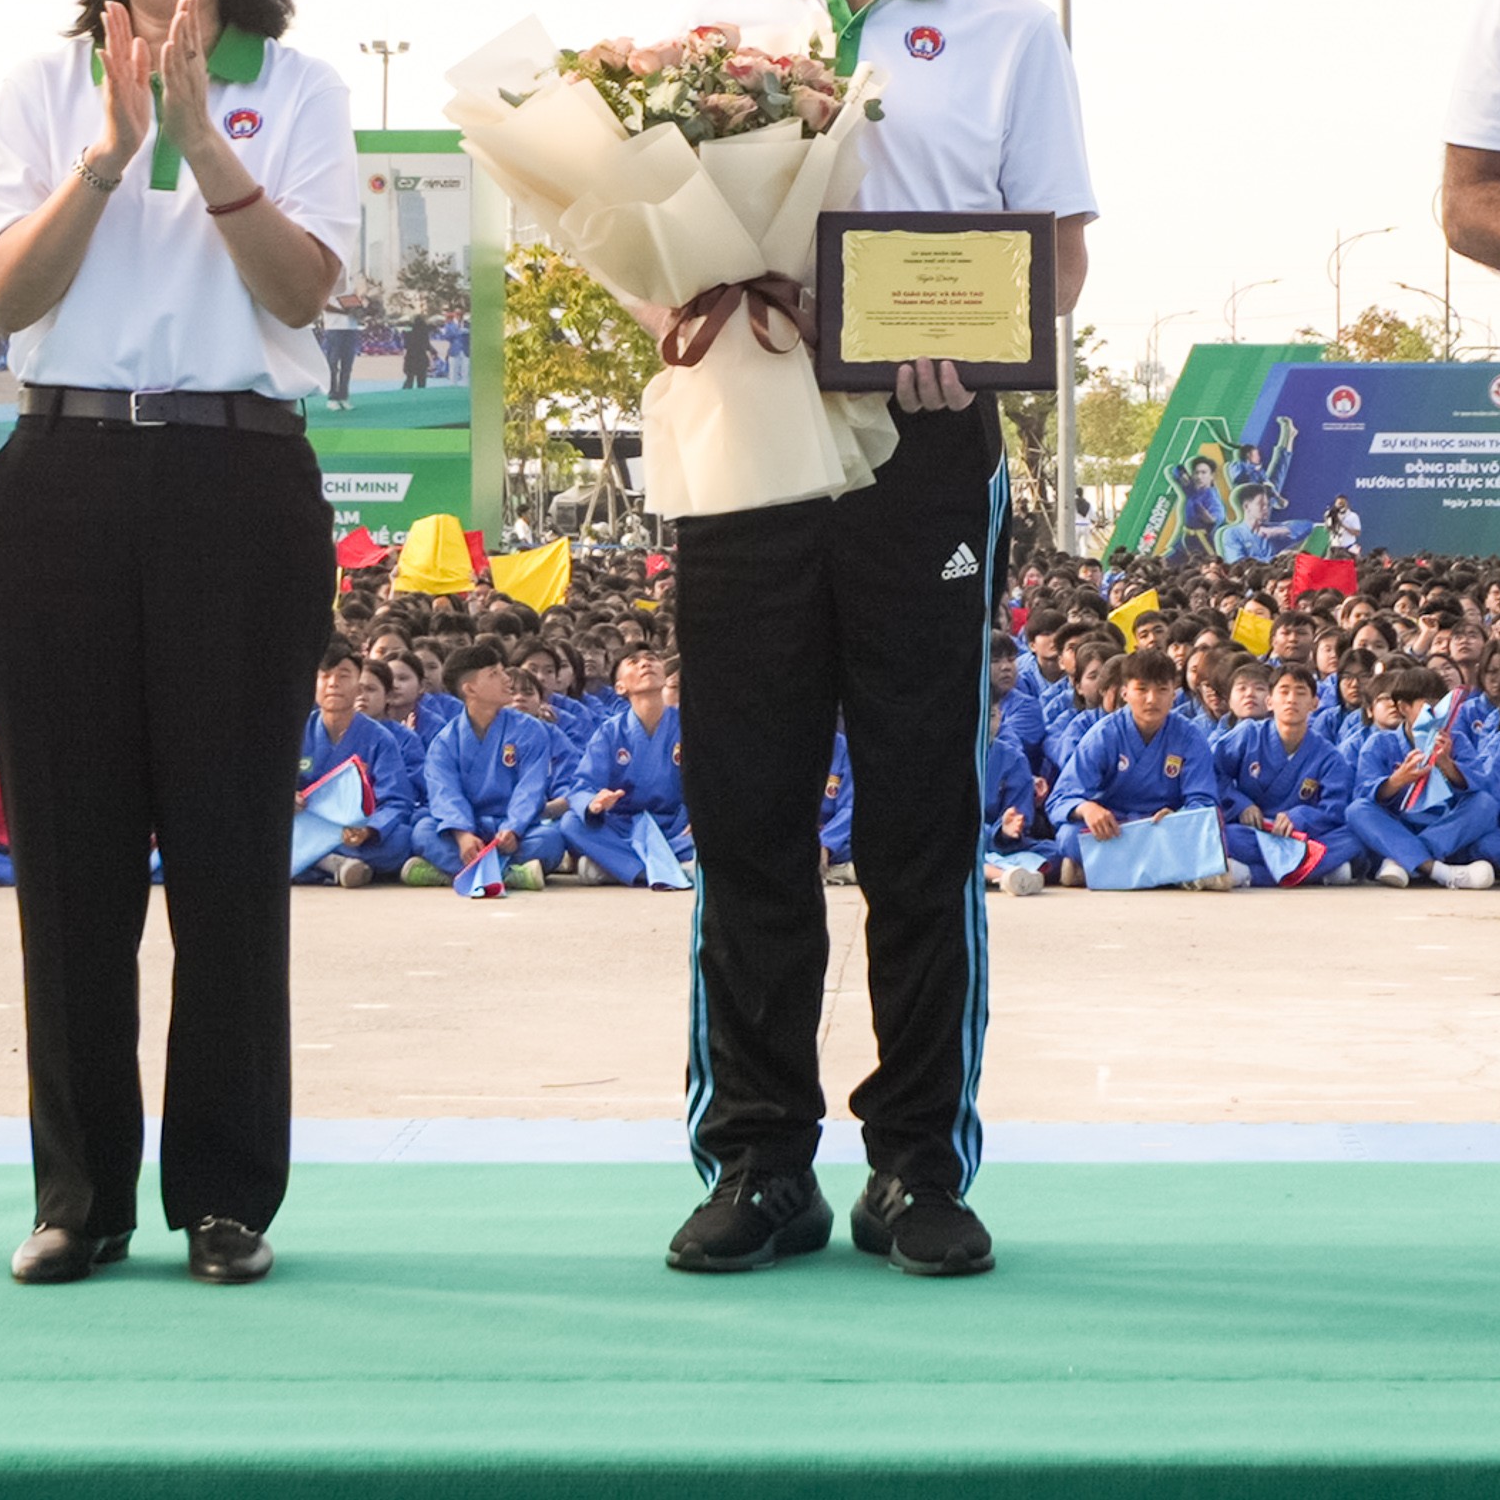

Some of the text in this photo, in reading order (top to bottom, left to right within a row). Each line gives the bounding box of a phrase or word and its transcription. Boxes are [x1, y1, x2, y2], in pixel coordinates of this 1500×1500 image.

[1400, 436, 1427, 451] KIỆN
[1430, 438, 1455, 451] HỌC
[1458, 438, 1486, 448] SINH
[324, 478, 399, 493] CHÍ MINH
[1442, 498, 1468, 509] Ngày
